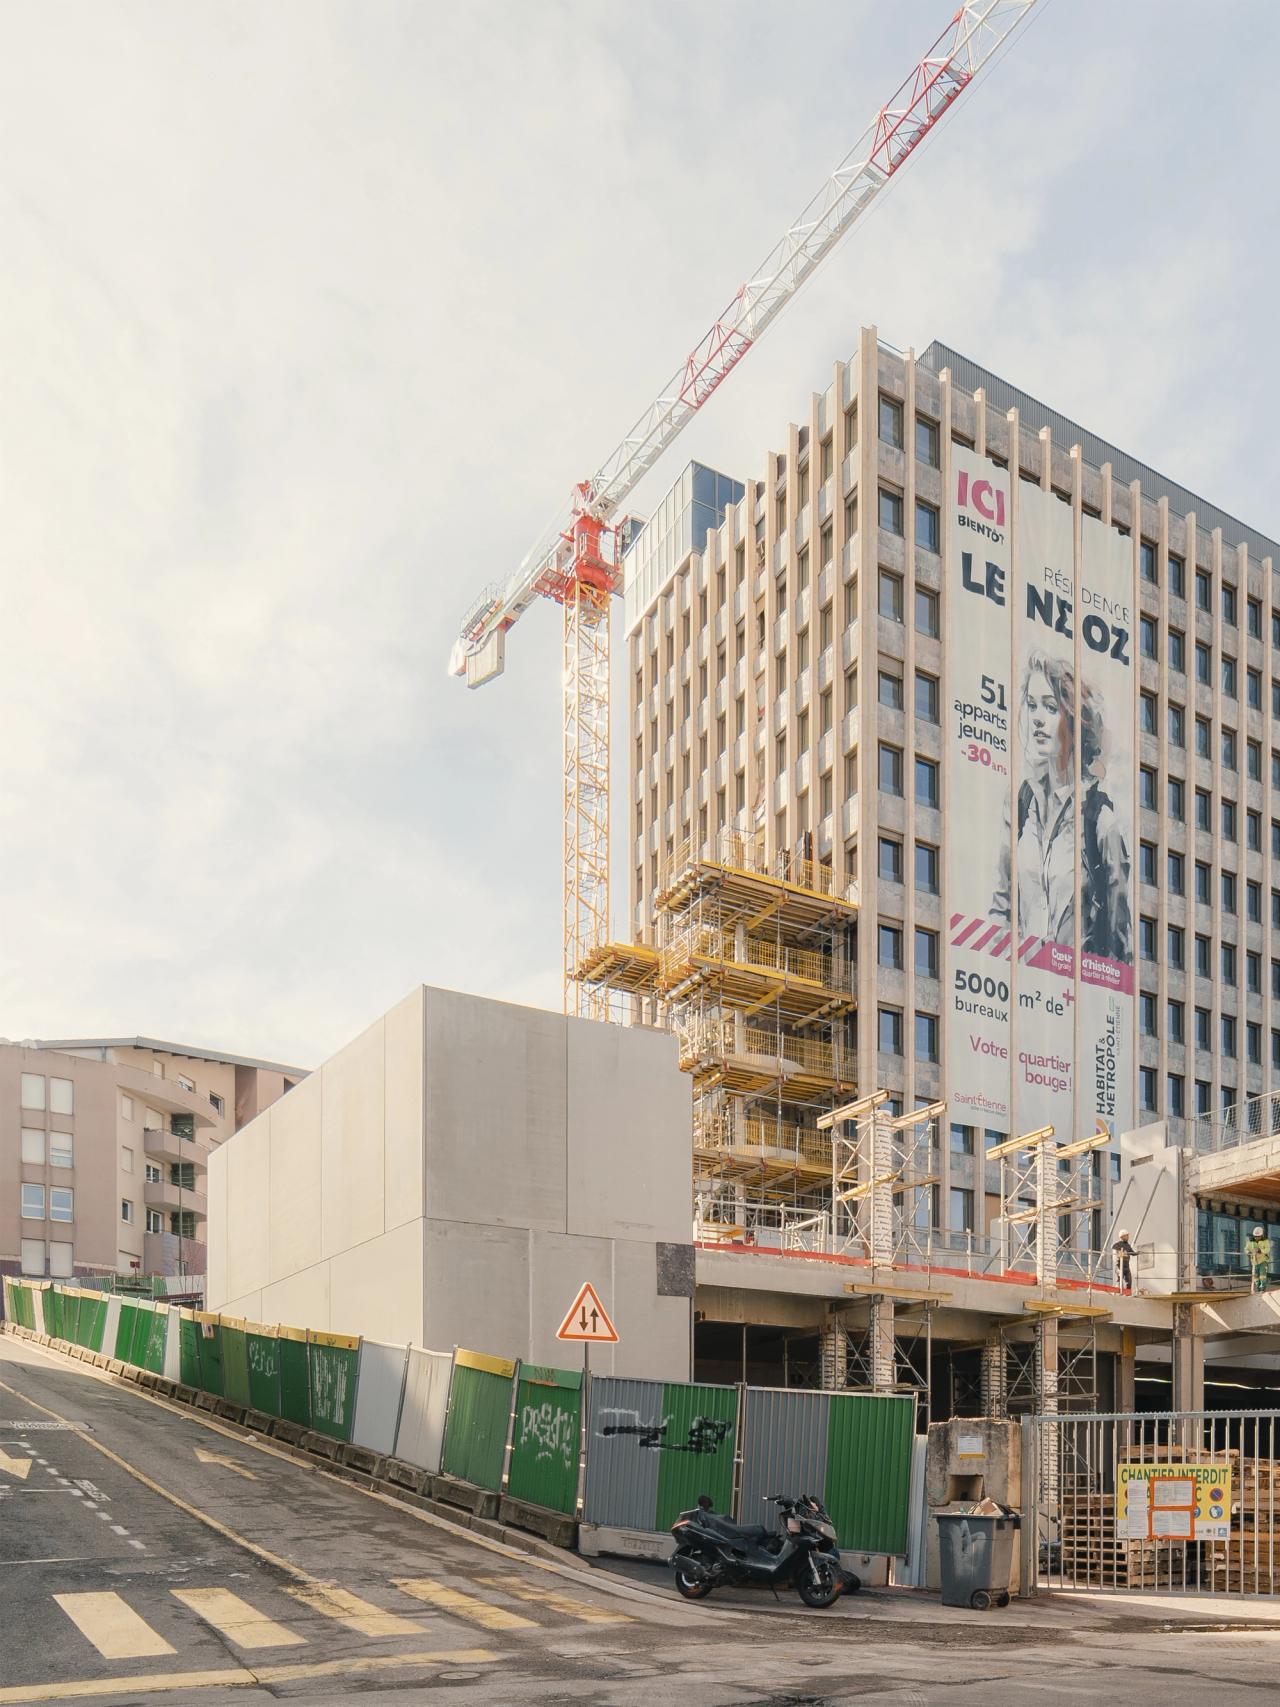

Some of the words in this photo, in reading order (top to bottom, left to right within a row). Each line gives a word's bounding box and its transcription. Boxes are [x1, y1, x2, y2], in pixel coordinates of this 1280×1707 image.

[957, 469, 1006, 527] ICI
[961, 551, 1006, 607] LE
[1044, 566, 1130, 625] RÉSIDENCE
[980, 674, 1008, 711] 51
[953, 698, 1008, 732] apparts
[957, 716, 1008, 754] jeunes
[991, 761, 1008, 776] ans
[954, 968, 1010, 1003] 5000
[1045, 996, 1064, 1016] de
[954, 995, 1009, 1023] bureaux
[969, 1034, 1008, 1060] Votre
[1018, 1051, 1072, 1074] quartier
[1106, 1014, 1116, 1116] METROPOLE
[1095, 1044, 1106, 1115] HABITAT
[1177, 1467, 1229, 1485] INTERDIT
